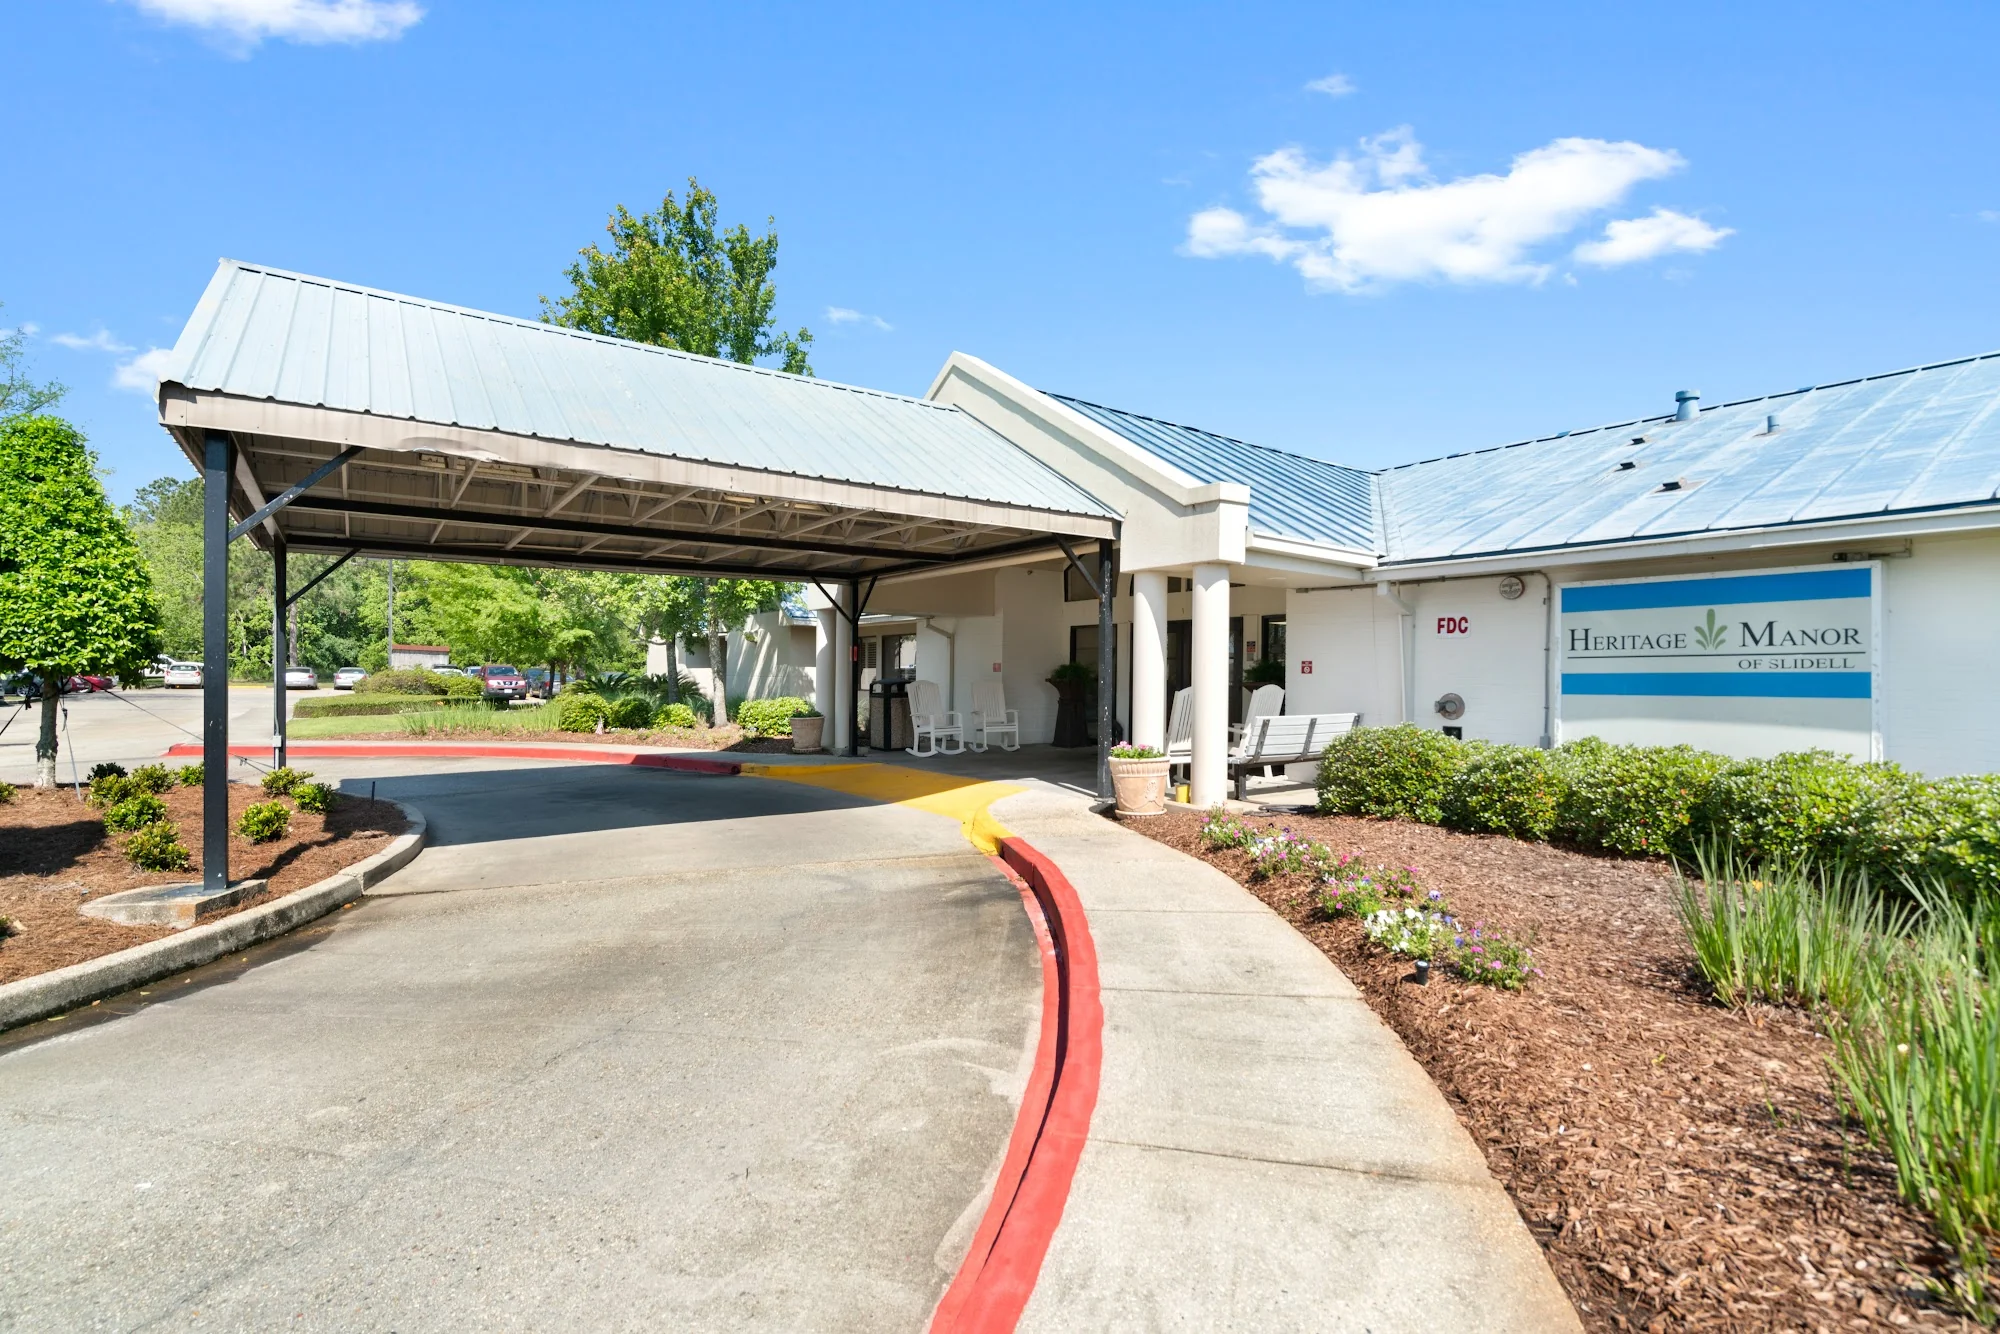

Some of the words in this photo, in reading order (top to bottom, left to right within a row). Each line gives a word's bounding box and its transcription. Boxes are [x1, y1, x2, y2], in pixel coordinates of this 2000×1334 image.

[1437, 616, 1469, 634] FDC
[1568, 628, 1687, 651] HERITAGE
[1738, 620, 1862, 648] MANOR
[1738, 659, 1763, 670] OF
[1768, 658, 1855, 670] SLIDELL
